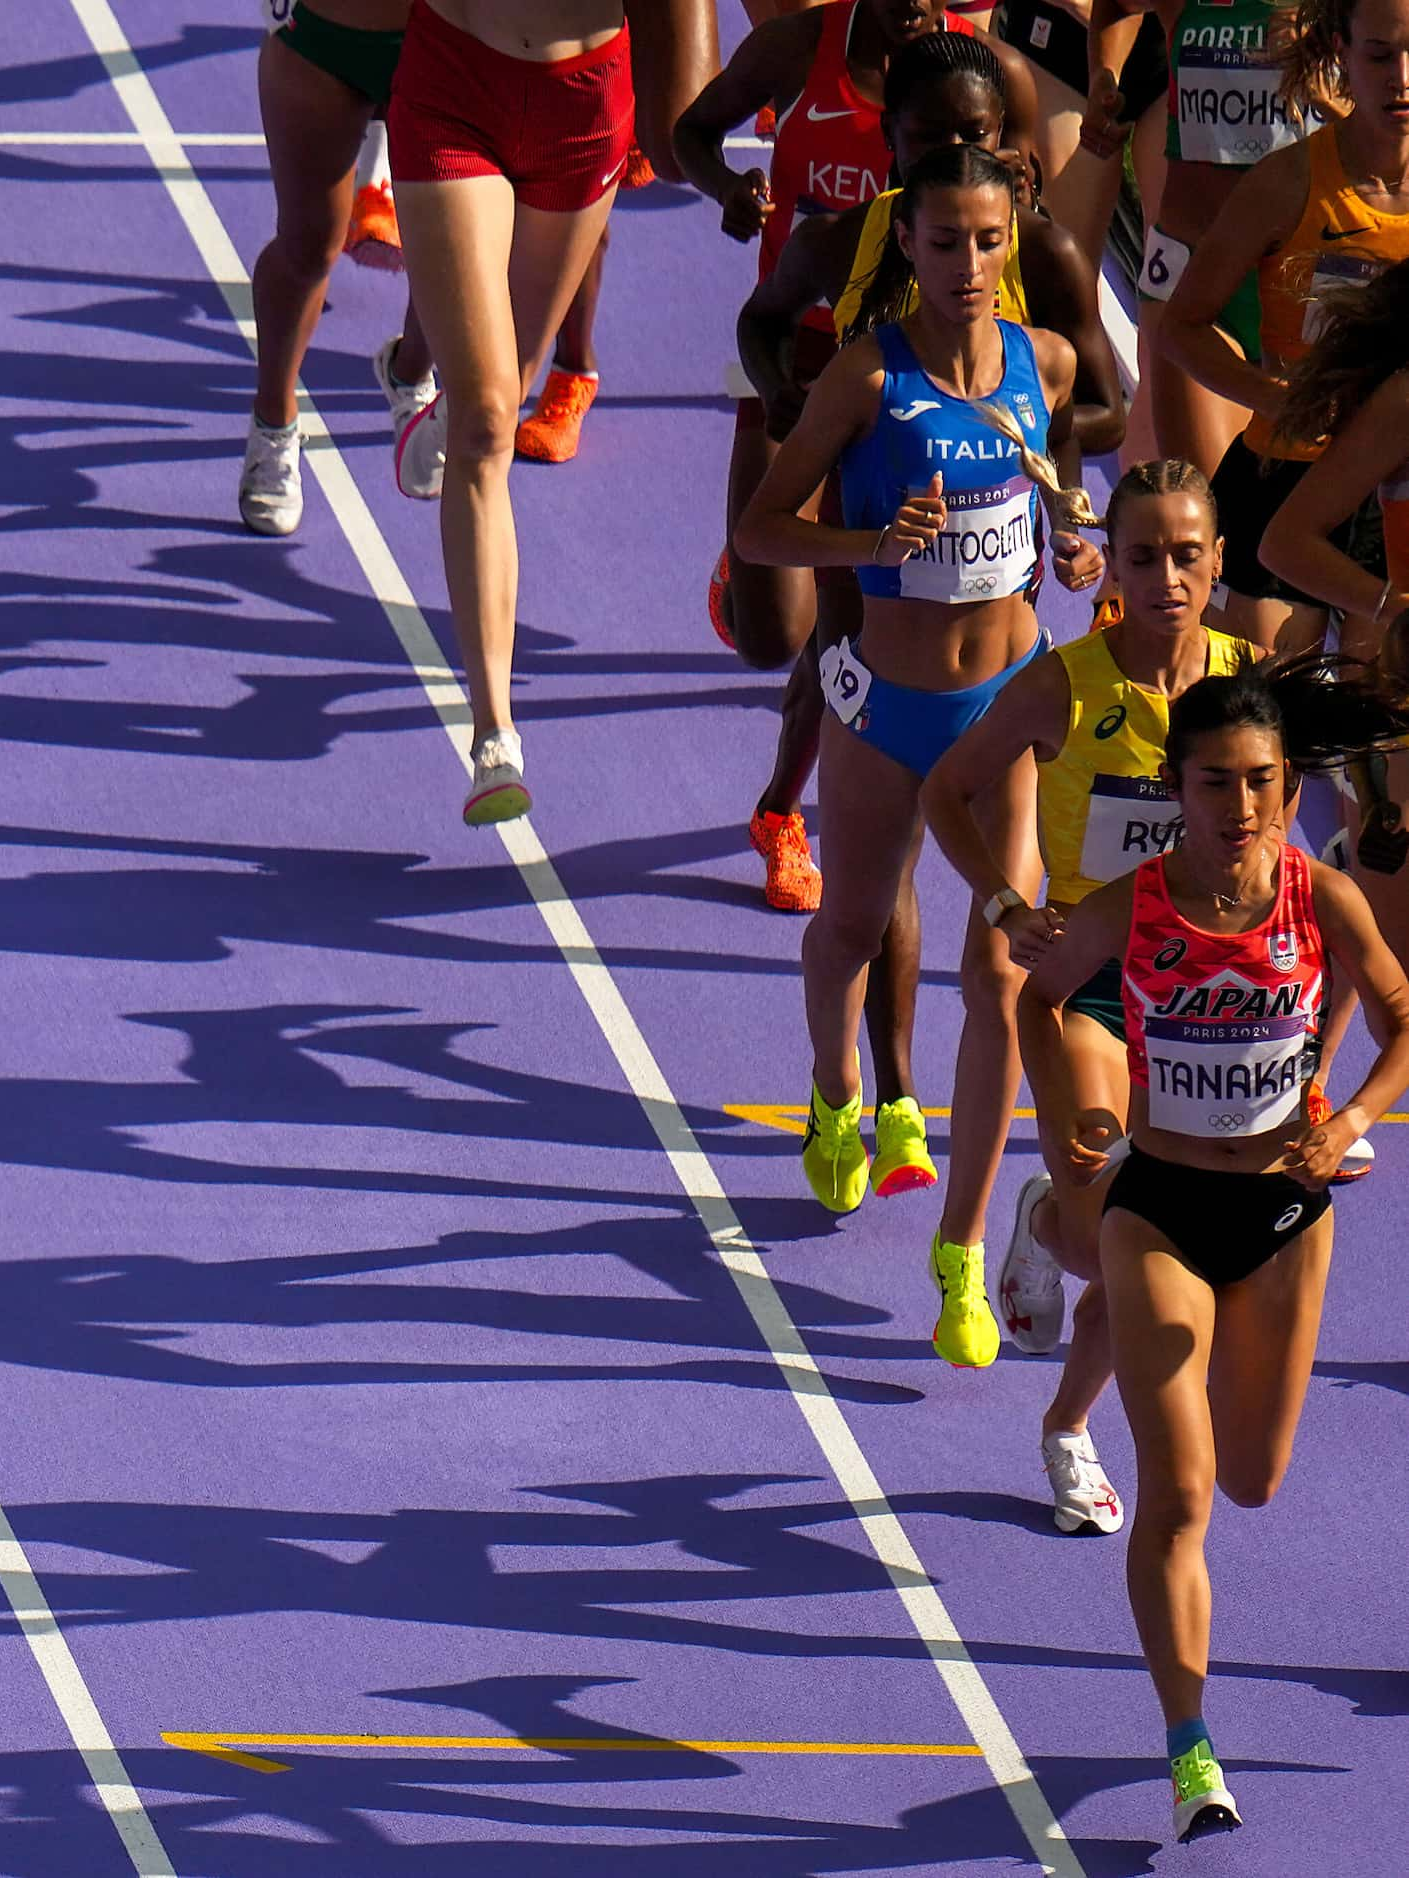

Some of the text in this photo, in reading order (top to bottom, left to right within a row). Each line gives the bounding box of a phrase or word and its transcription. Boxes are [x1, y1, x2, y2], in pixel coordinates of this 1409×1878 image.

[1180, 88, 1326, 125] MACHA
[1149, 248, 1169, 285] 6
[926, 438, 1021, 460] ITALIA
[1155, 982, 1303, 1019] JAPAN
[1184, 1026, 1270, 1038] PARIS 2024
[1152, 1055, 1296, 1101] TANAKA
